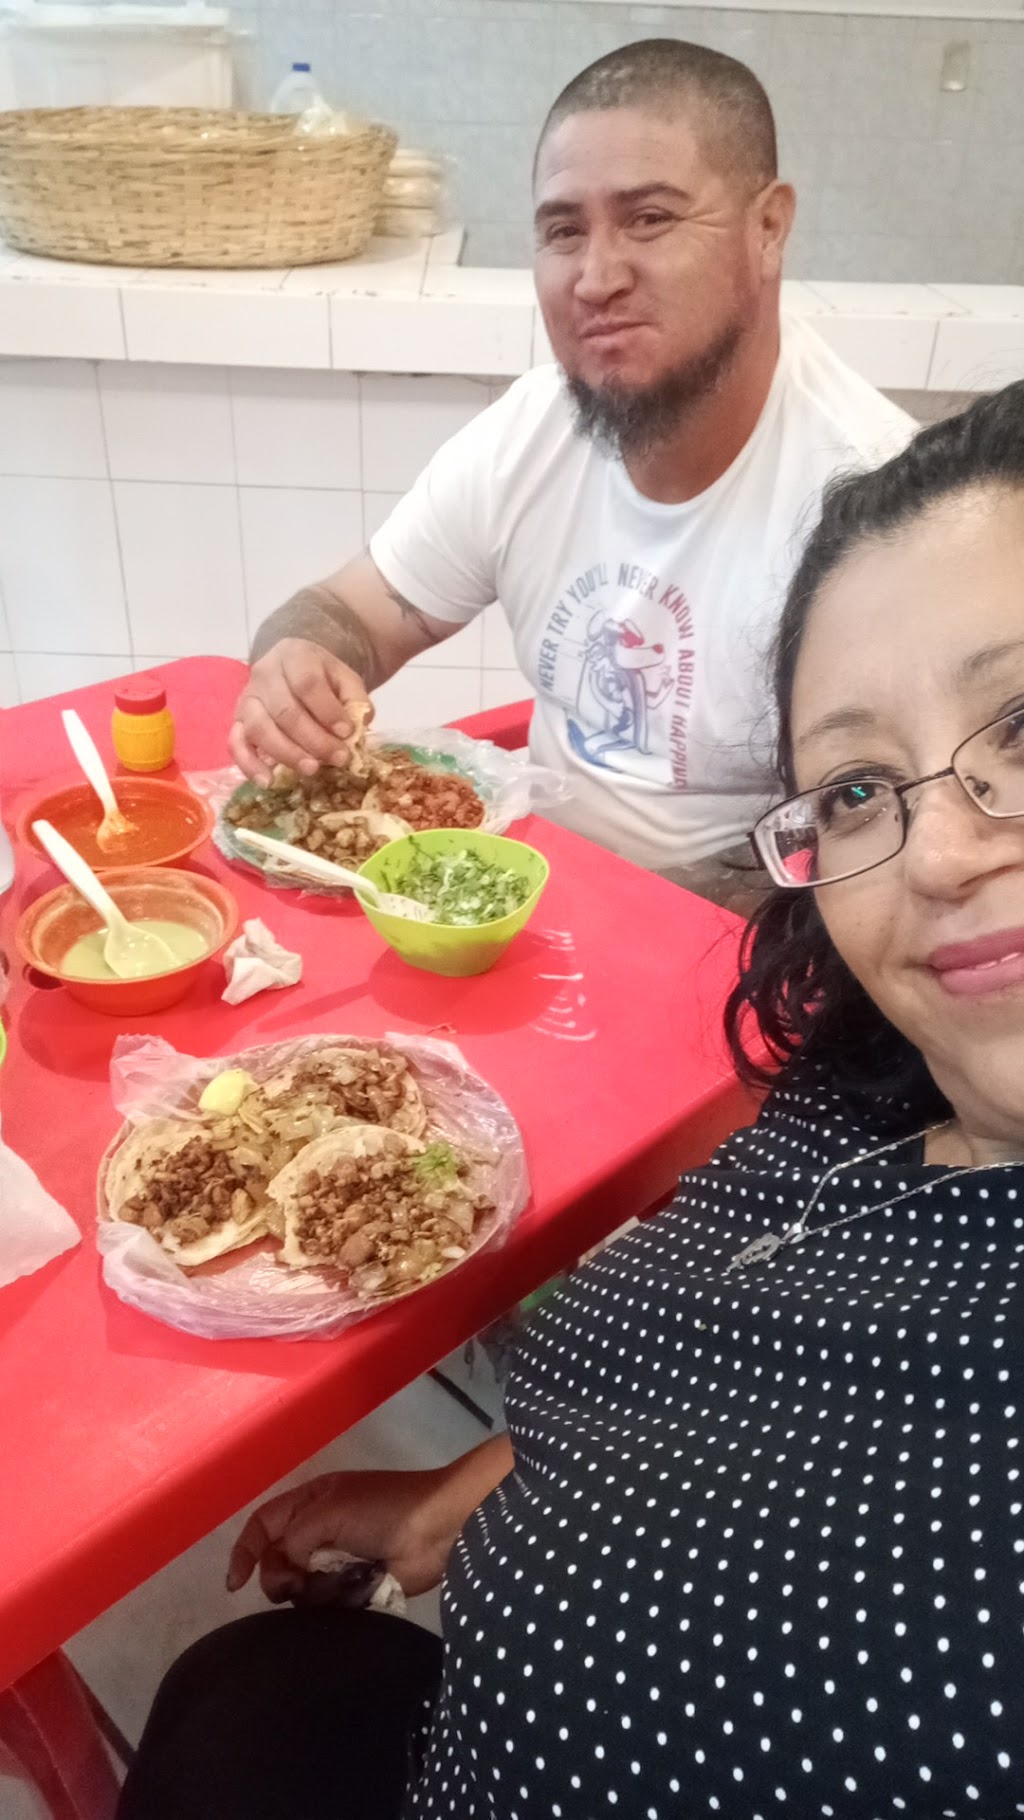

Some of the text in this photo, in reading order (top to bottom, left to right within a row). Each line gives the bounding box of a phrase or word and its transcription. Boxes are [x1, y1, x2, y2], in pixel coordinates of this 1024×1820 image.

[617, 562, 660, 600] NEVER
[547, 600, 573, 636] TRY
[658, 584, 695, 640] KNOW
[538, 638, 559, 691] NEVER
[674, 649, 695, 708] ABOUT
[669, 714, 688, 791] HAPPINE
